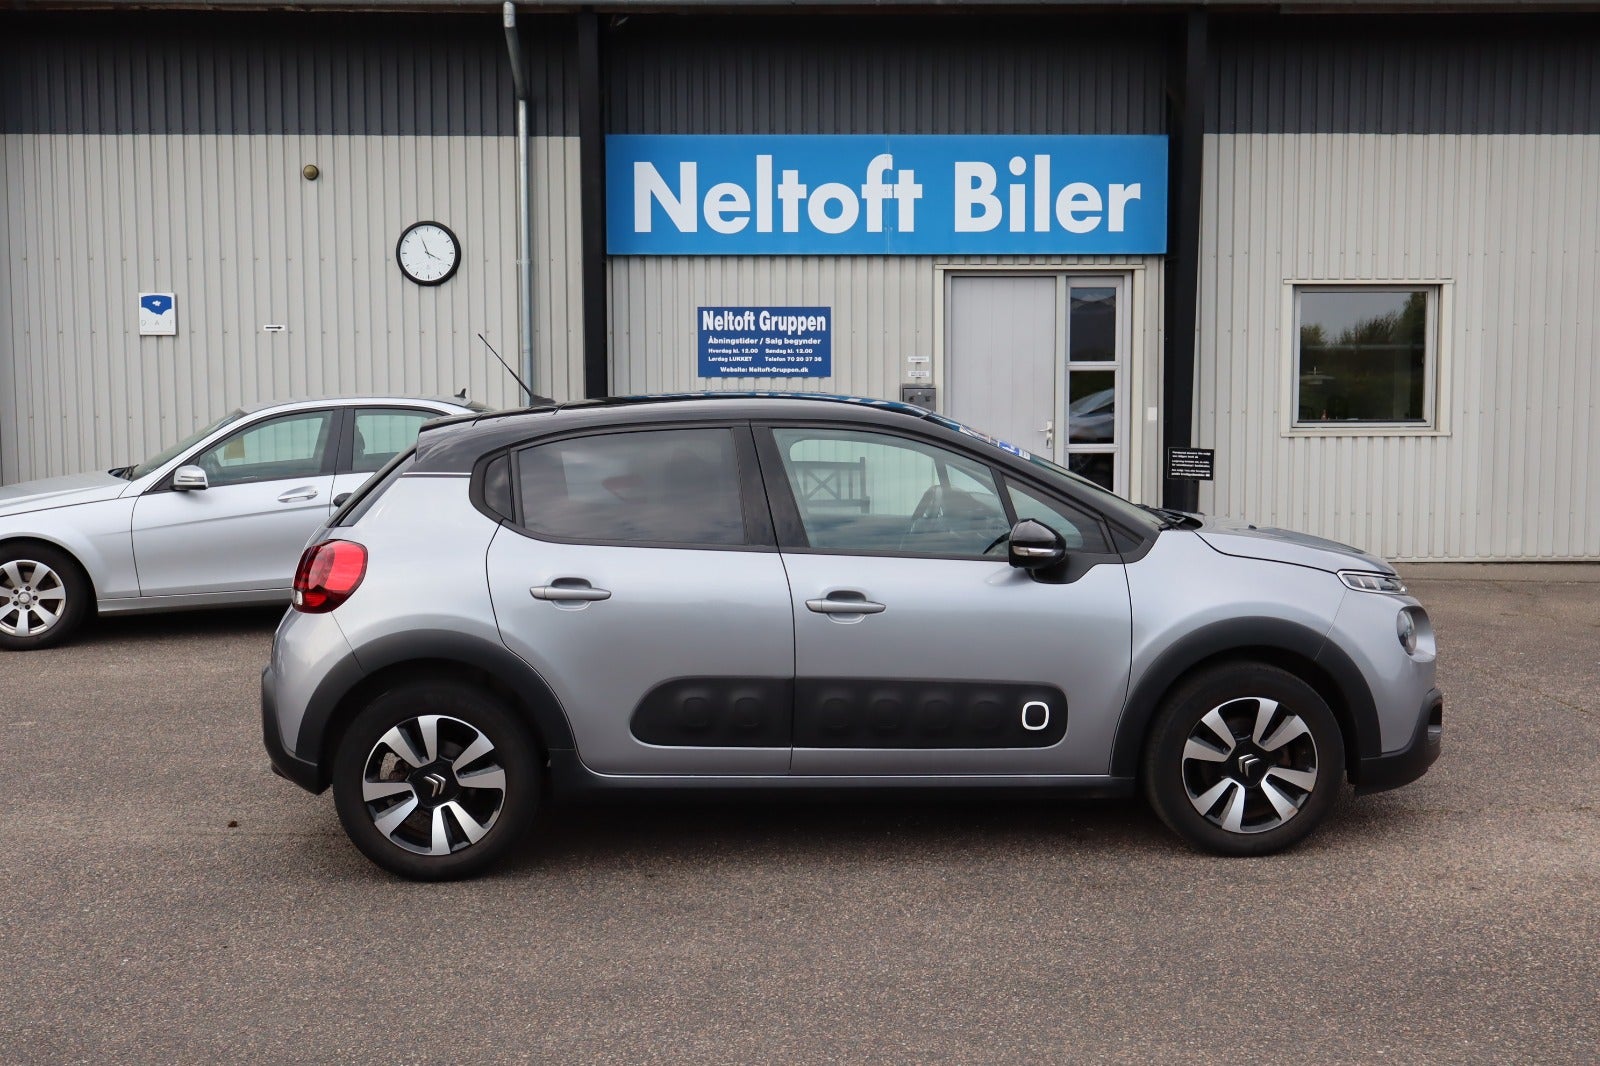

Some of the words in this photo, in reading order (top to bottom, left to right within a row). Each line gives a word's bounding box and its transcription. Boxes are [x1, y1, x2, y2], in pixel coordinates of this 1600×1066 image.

[634, 154, 923, 234] Neltoft
[955, 155, 1142, 234] Biler
[703, 311, 755, 331] Neltoft
[759, 311, 826, 335] Gruppen
[708, 336, 759, 346] Åbningstider
[765, 338, 783, 346] Salg
[784, 338, 822, 346] begynder
[749, 366, 809, 374] Neltoft-Gruppen.dk
